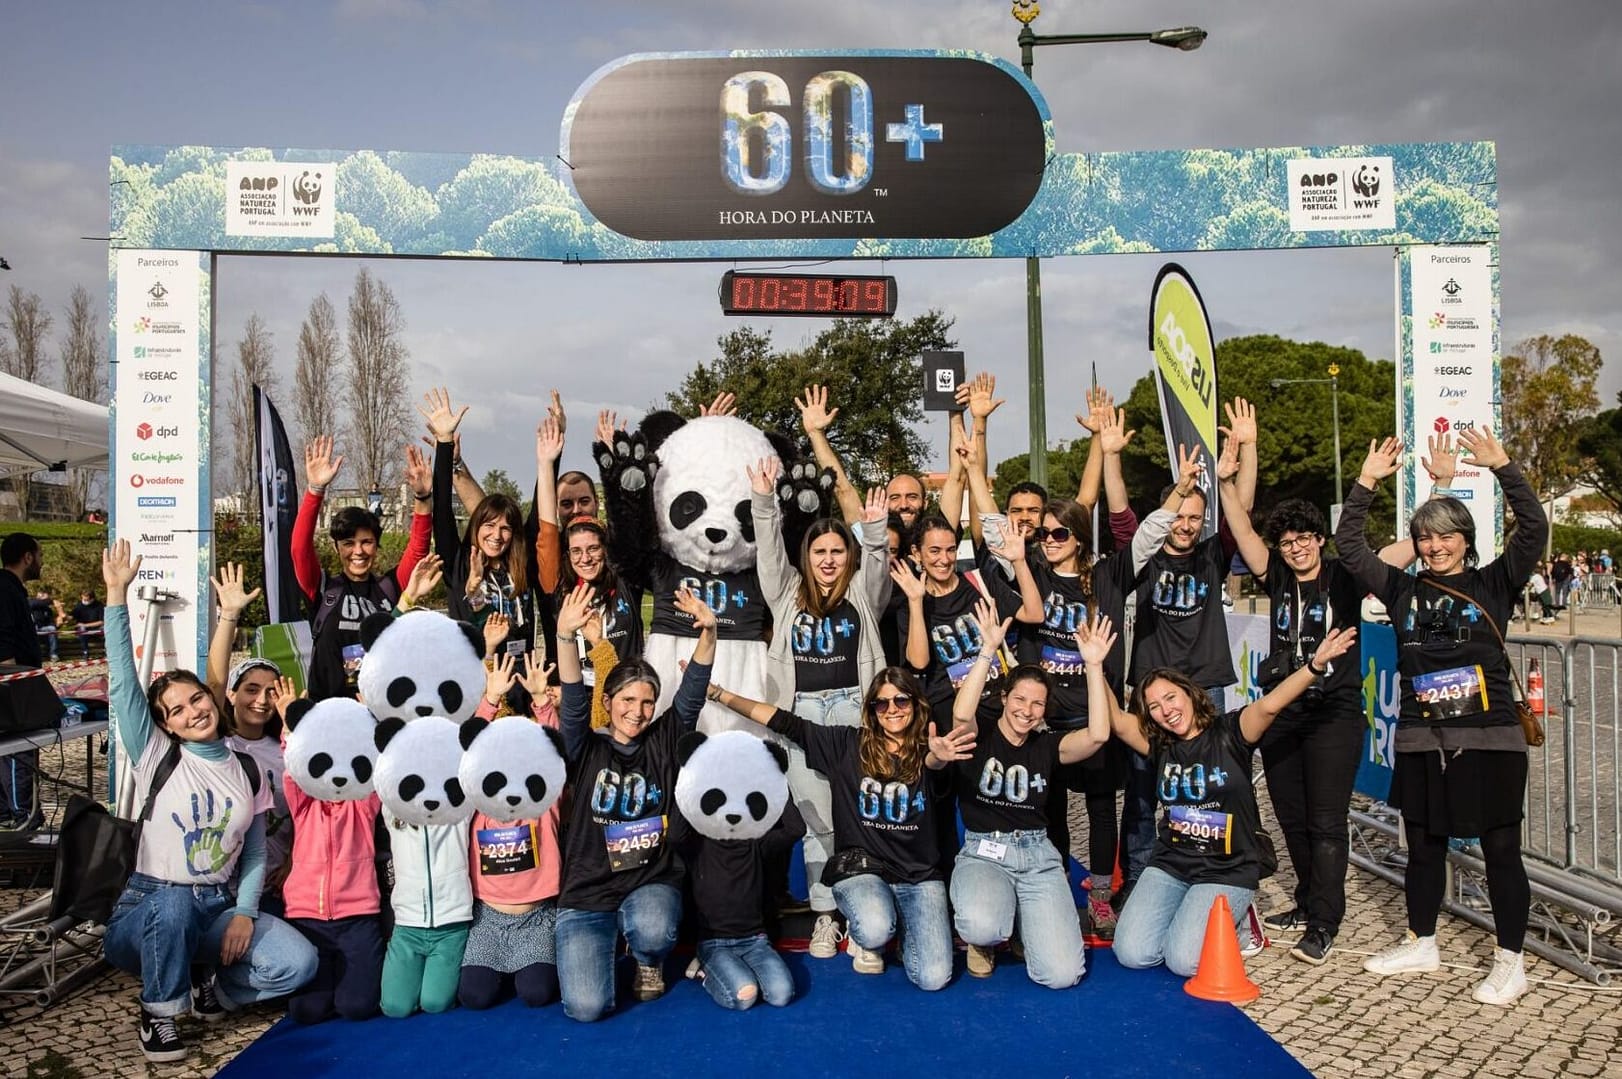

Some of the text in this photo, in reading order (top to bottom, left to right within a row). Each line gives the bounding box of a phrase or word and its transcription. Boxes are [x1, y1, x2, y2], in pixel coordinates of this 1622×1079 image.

[719, 71, 944, 196] 60+
[240, 177, 279, 191] ANP
[1300, 173, 1338, 187] ANP
[240, 200, 276, 208] NATUREZA
[1302, 203, 1338, 211] PORTUGAL
[1353, 200, 1381, 209] WWF
[240, 208, 276, 216] PORTUGAL
[293, 207, 321, 217] WWF
[719, 210, 876, 225] HORA DO PLANETA
[137, 257, 179, 267] Parceiros
[1431, 255, 1472, 264] Parceiros
[734, 278, 885, 312] 00:39:09
[144, 371, 178, 381] EGEAC
[1440, 366, 1472, 375] EGEAC
[142, 391, 172, 403] Dove
[1439, 386, 1467, 398] Dove
[156, 425, 179, 439] dpd
[1453, 470, 1481, 478] dafone
[145, 476, 184, 485] vodafone
[138, 533, 175, 542] Marriott
[138, 570, 164, 580] REN
[675, 611, 736, 625] HORA ANETA
[607, 630, 627, 639] ANETA
[791, 613, 856, 656] 60+
[1056, 632, 1067, 640] DO
[809, 656, 820, 664] DO
[819, 655, 847, 664] PLANETA
[1428, 678, 1473, 704] 2437
[979, 757, 1048, 803] 60+
[1157, 763, 1229, 801] 60+
[591, 767, 662, 817] 60+
[858, 777, 927, 823] 60+
[875, 822, 886, 830] DO
[887, 824, 919, 832] PLANETA
[1181, 821, 1220, 841] 2001
[619, 831, 660, 854] 2452
[488, 839, 528, 859] 2374
